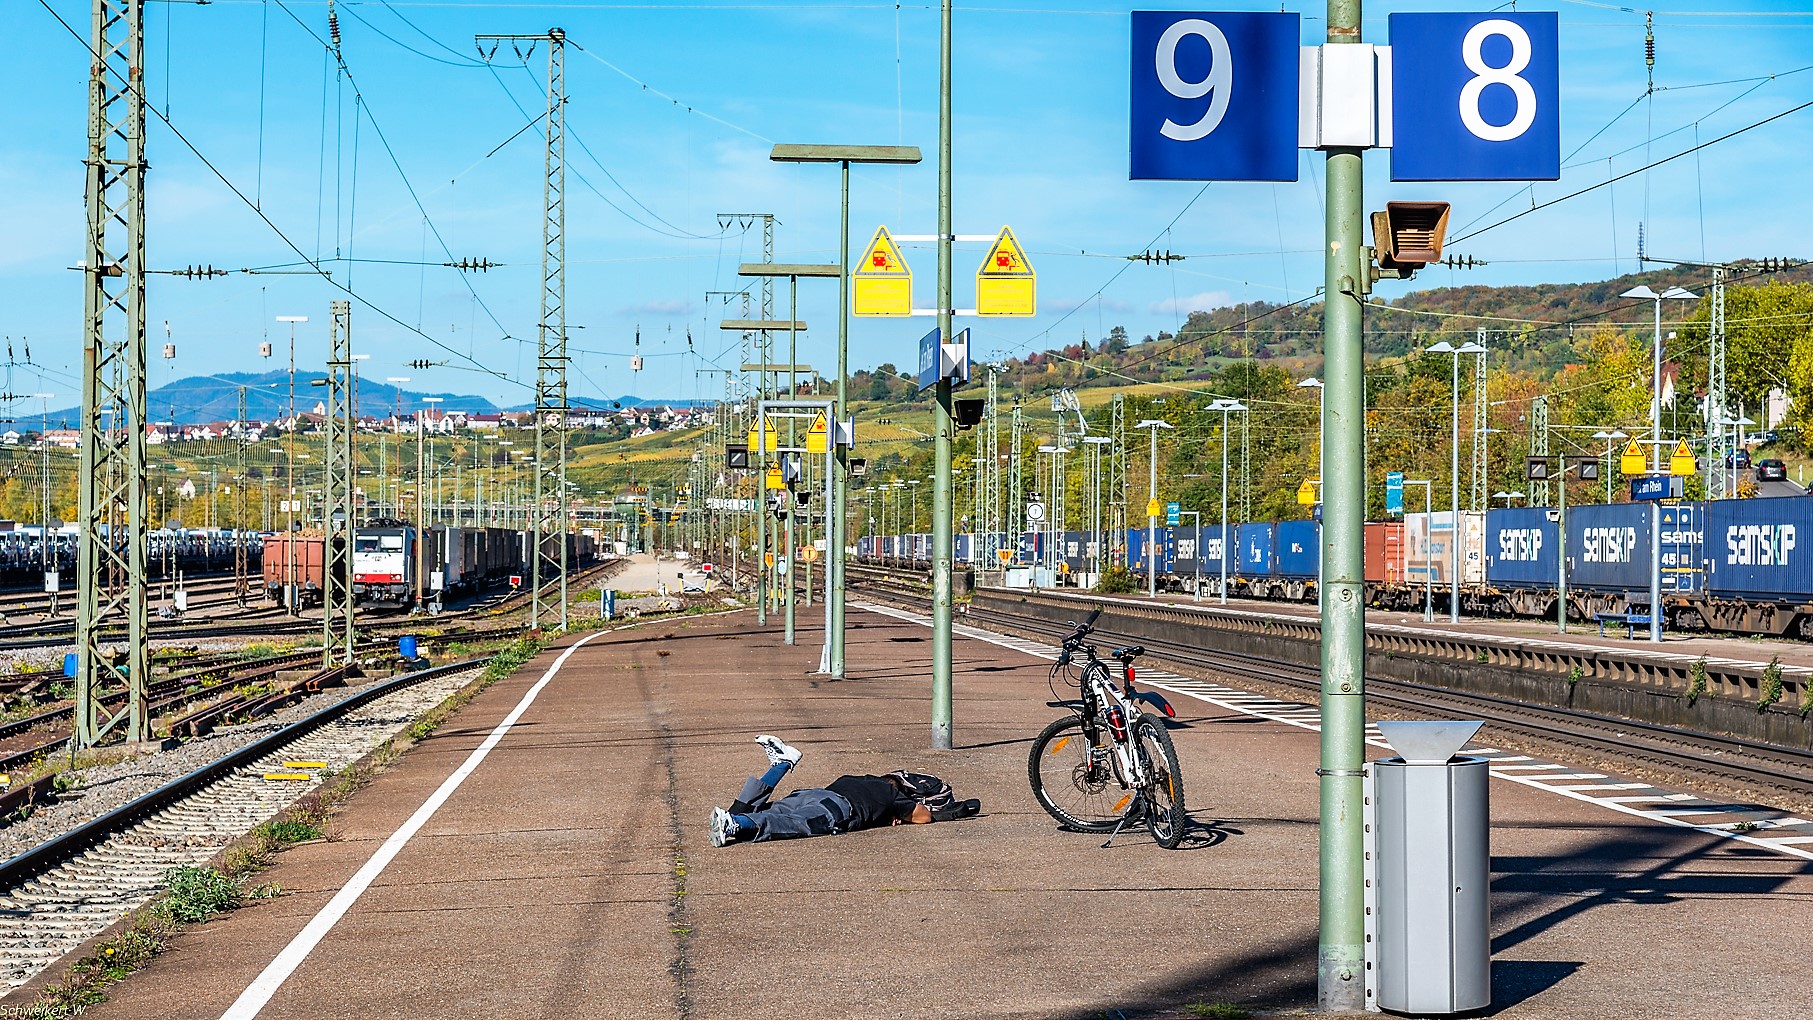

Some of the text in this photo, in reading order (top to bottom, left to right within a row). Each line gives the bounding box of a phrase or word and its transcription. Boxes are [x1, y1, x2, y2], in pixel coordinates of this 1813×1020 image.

[1155, 18, 1233, 142] 9
[1459, 18, 1537, 142] 8
[282, 502, 288, 511] 2
[294, 502, 299, 510] 1
[1468, 552, 1479, 560] 45
[1661, 553, 1677, 565] 45
